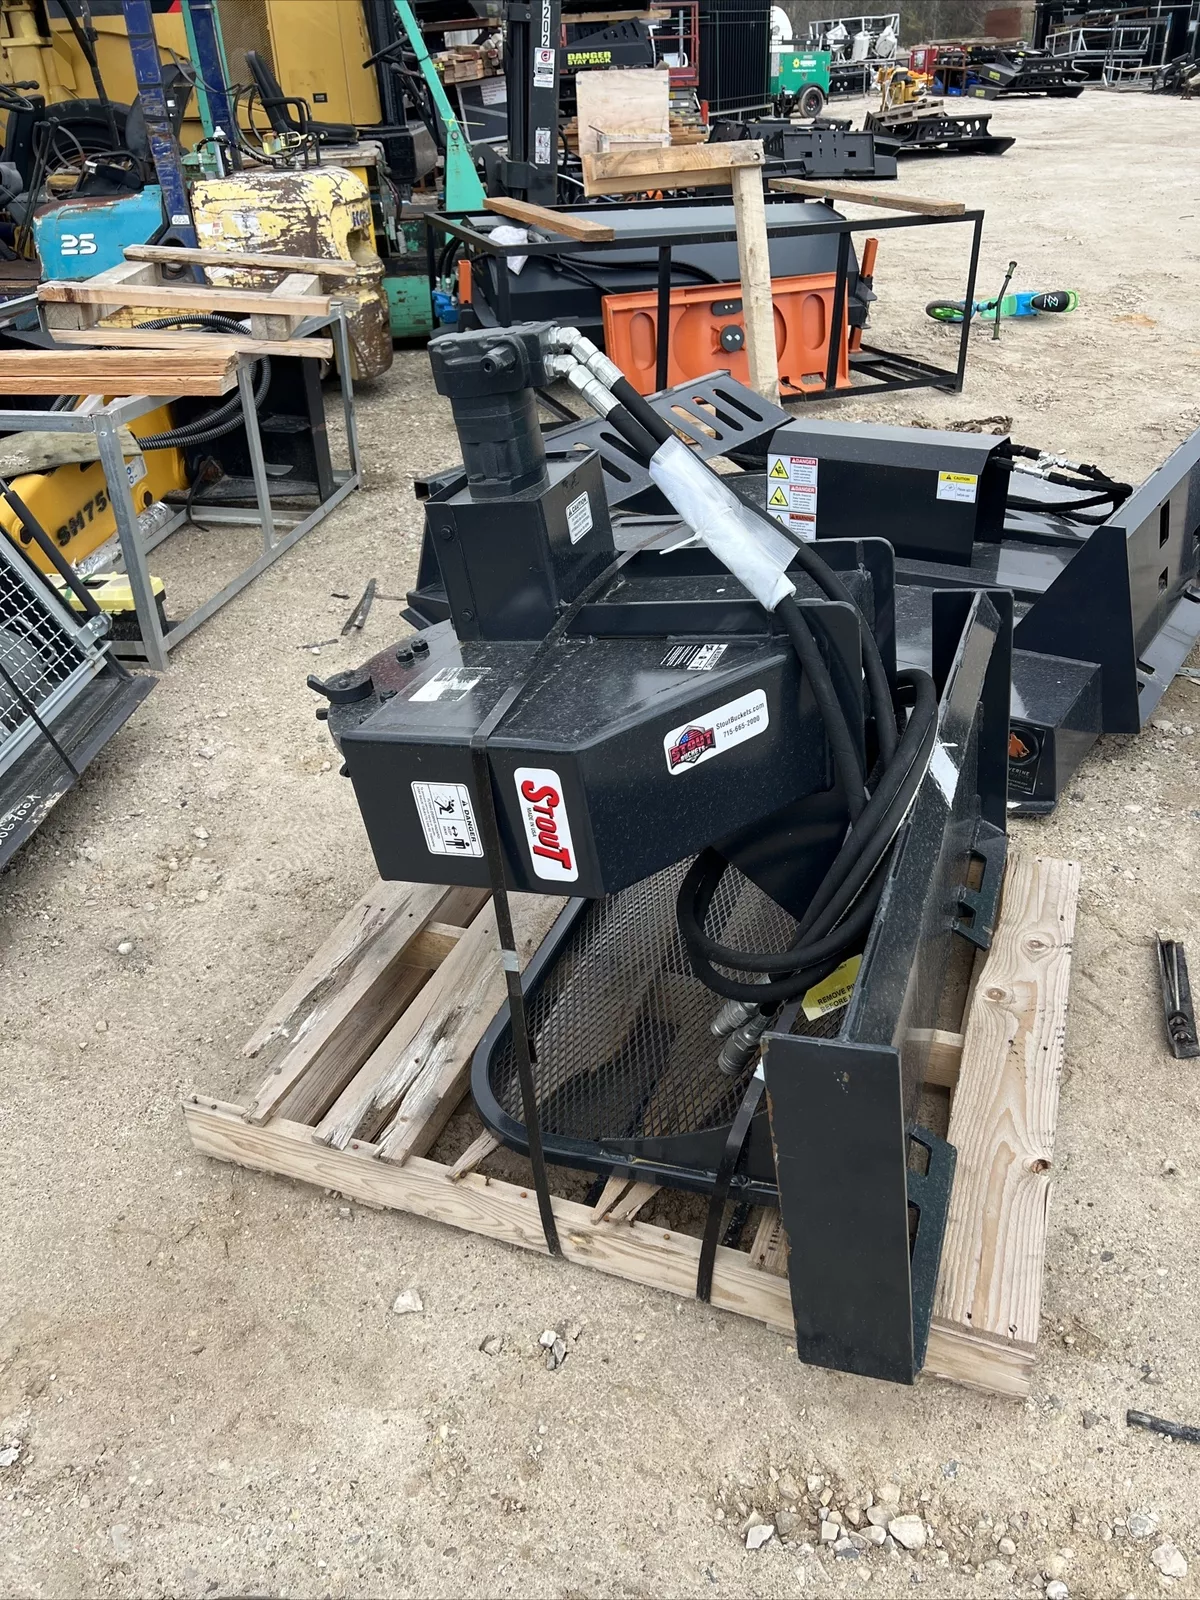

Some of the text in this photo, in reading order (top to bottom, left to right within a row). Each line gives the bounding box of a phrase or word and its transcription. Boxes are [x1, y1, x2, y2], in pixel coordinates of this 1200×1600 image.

[567, 51, 611, 60] DANGER
[60, 233, 97, 255] 25
[715, 702, 765, 730] StoutBuckets.com
[670, 731, 713, 763] STOUT
[463, 809, 477, 842] DANGER
[817, 987, 847, 1005] REMOVE
[820, 996, 849, 1013] BEFORE
